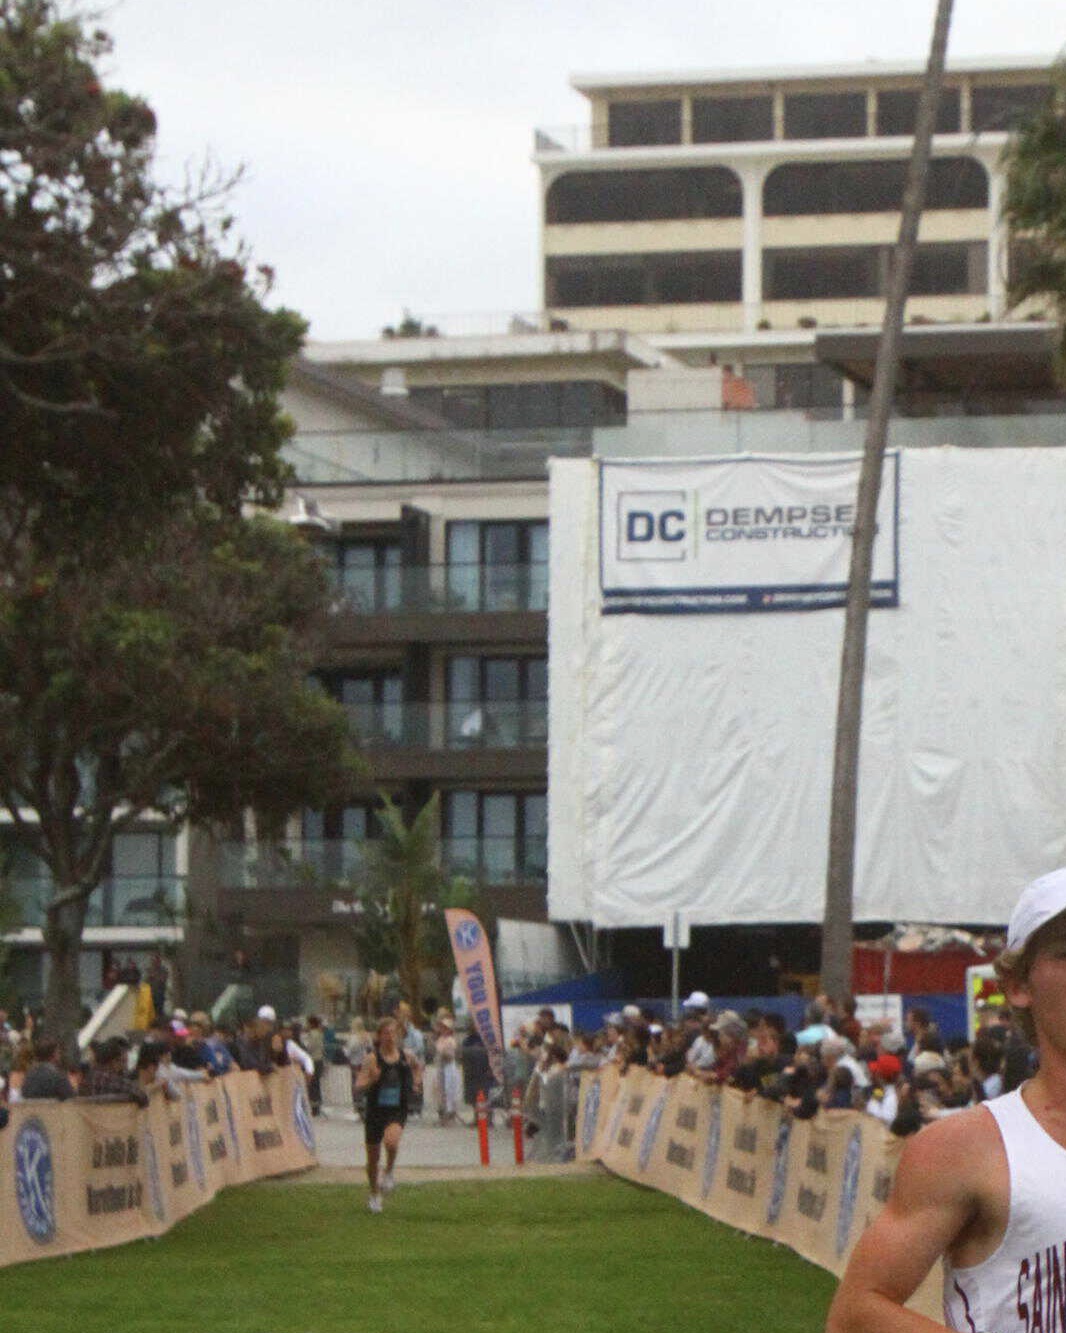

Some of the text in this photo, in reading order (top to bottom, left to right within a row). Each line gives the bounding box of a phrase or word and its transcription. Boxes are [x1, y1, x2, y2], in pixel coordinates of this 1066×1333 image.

[627, 510, 685, 542] DC
[706, 504, 857, 527] DEMPSE
[706, 524, 858, 542] CONSTRUCTI
